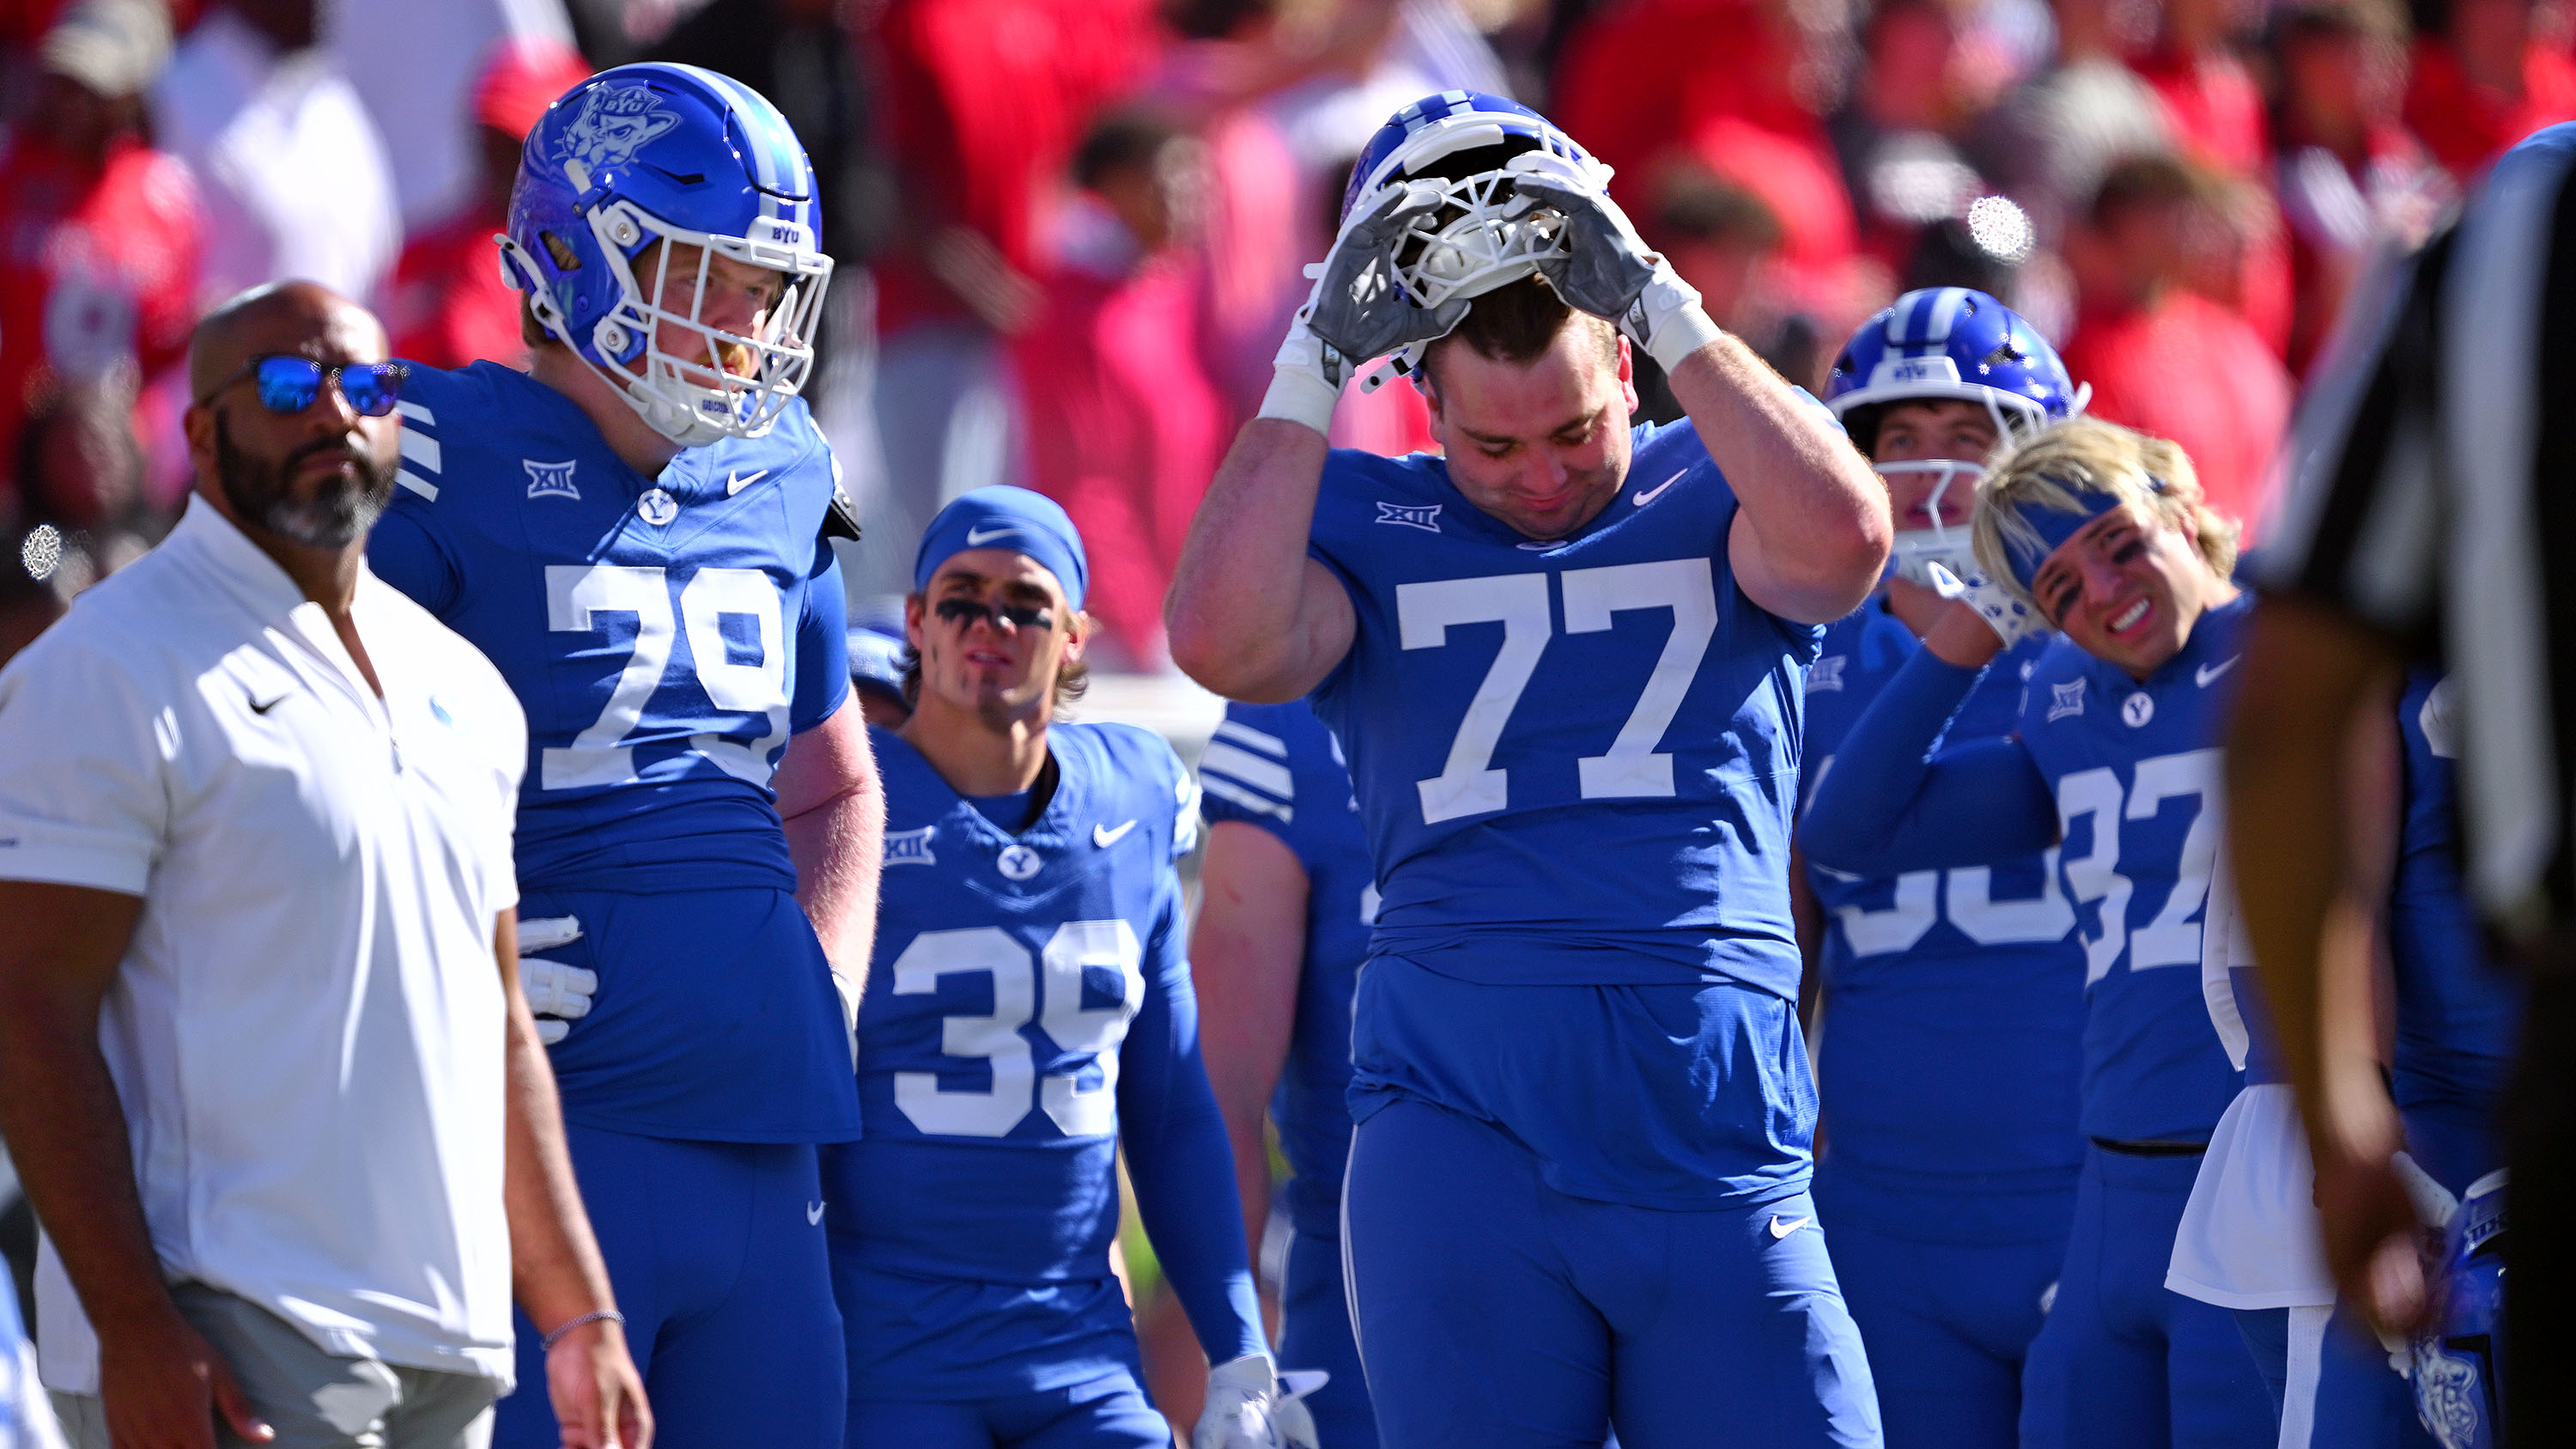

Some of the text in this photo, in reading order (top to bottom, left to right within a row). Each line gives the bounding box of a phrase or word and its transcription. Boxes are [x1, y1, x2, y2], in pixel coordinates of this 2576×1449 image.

[604, 99, 643, 113] BYU
[773, 226, 799, 243] BYU
[524, 460, 580, 499] XII
[644, 496, 669, 519] Y
[1375, 502, 1443, 533] XII
[542, 565, 790, 790] 79
[1395, 557, 1717, 825] 77
[2058, 748, 2226, 989] 37
[893, 919, 1145, 1138] 39
